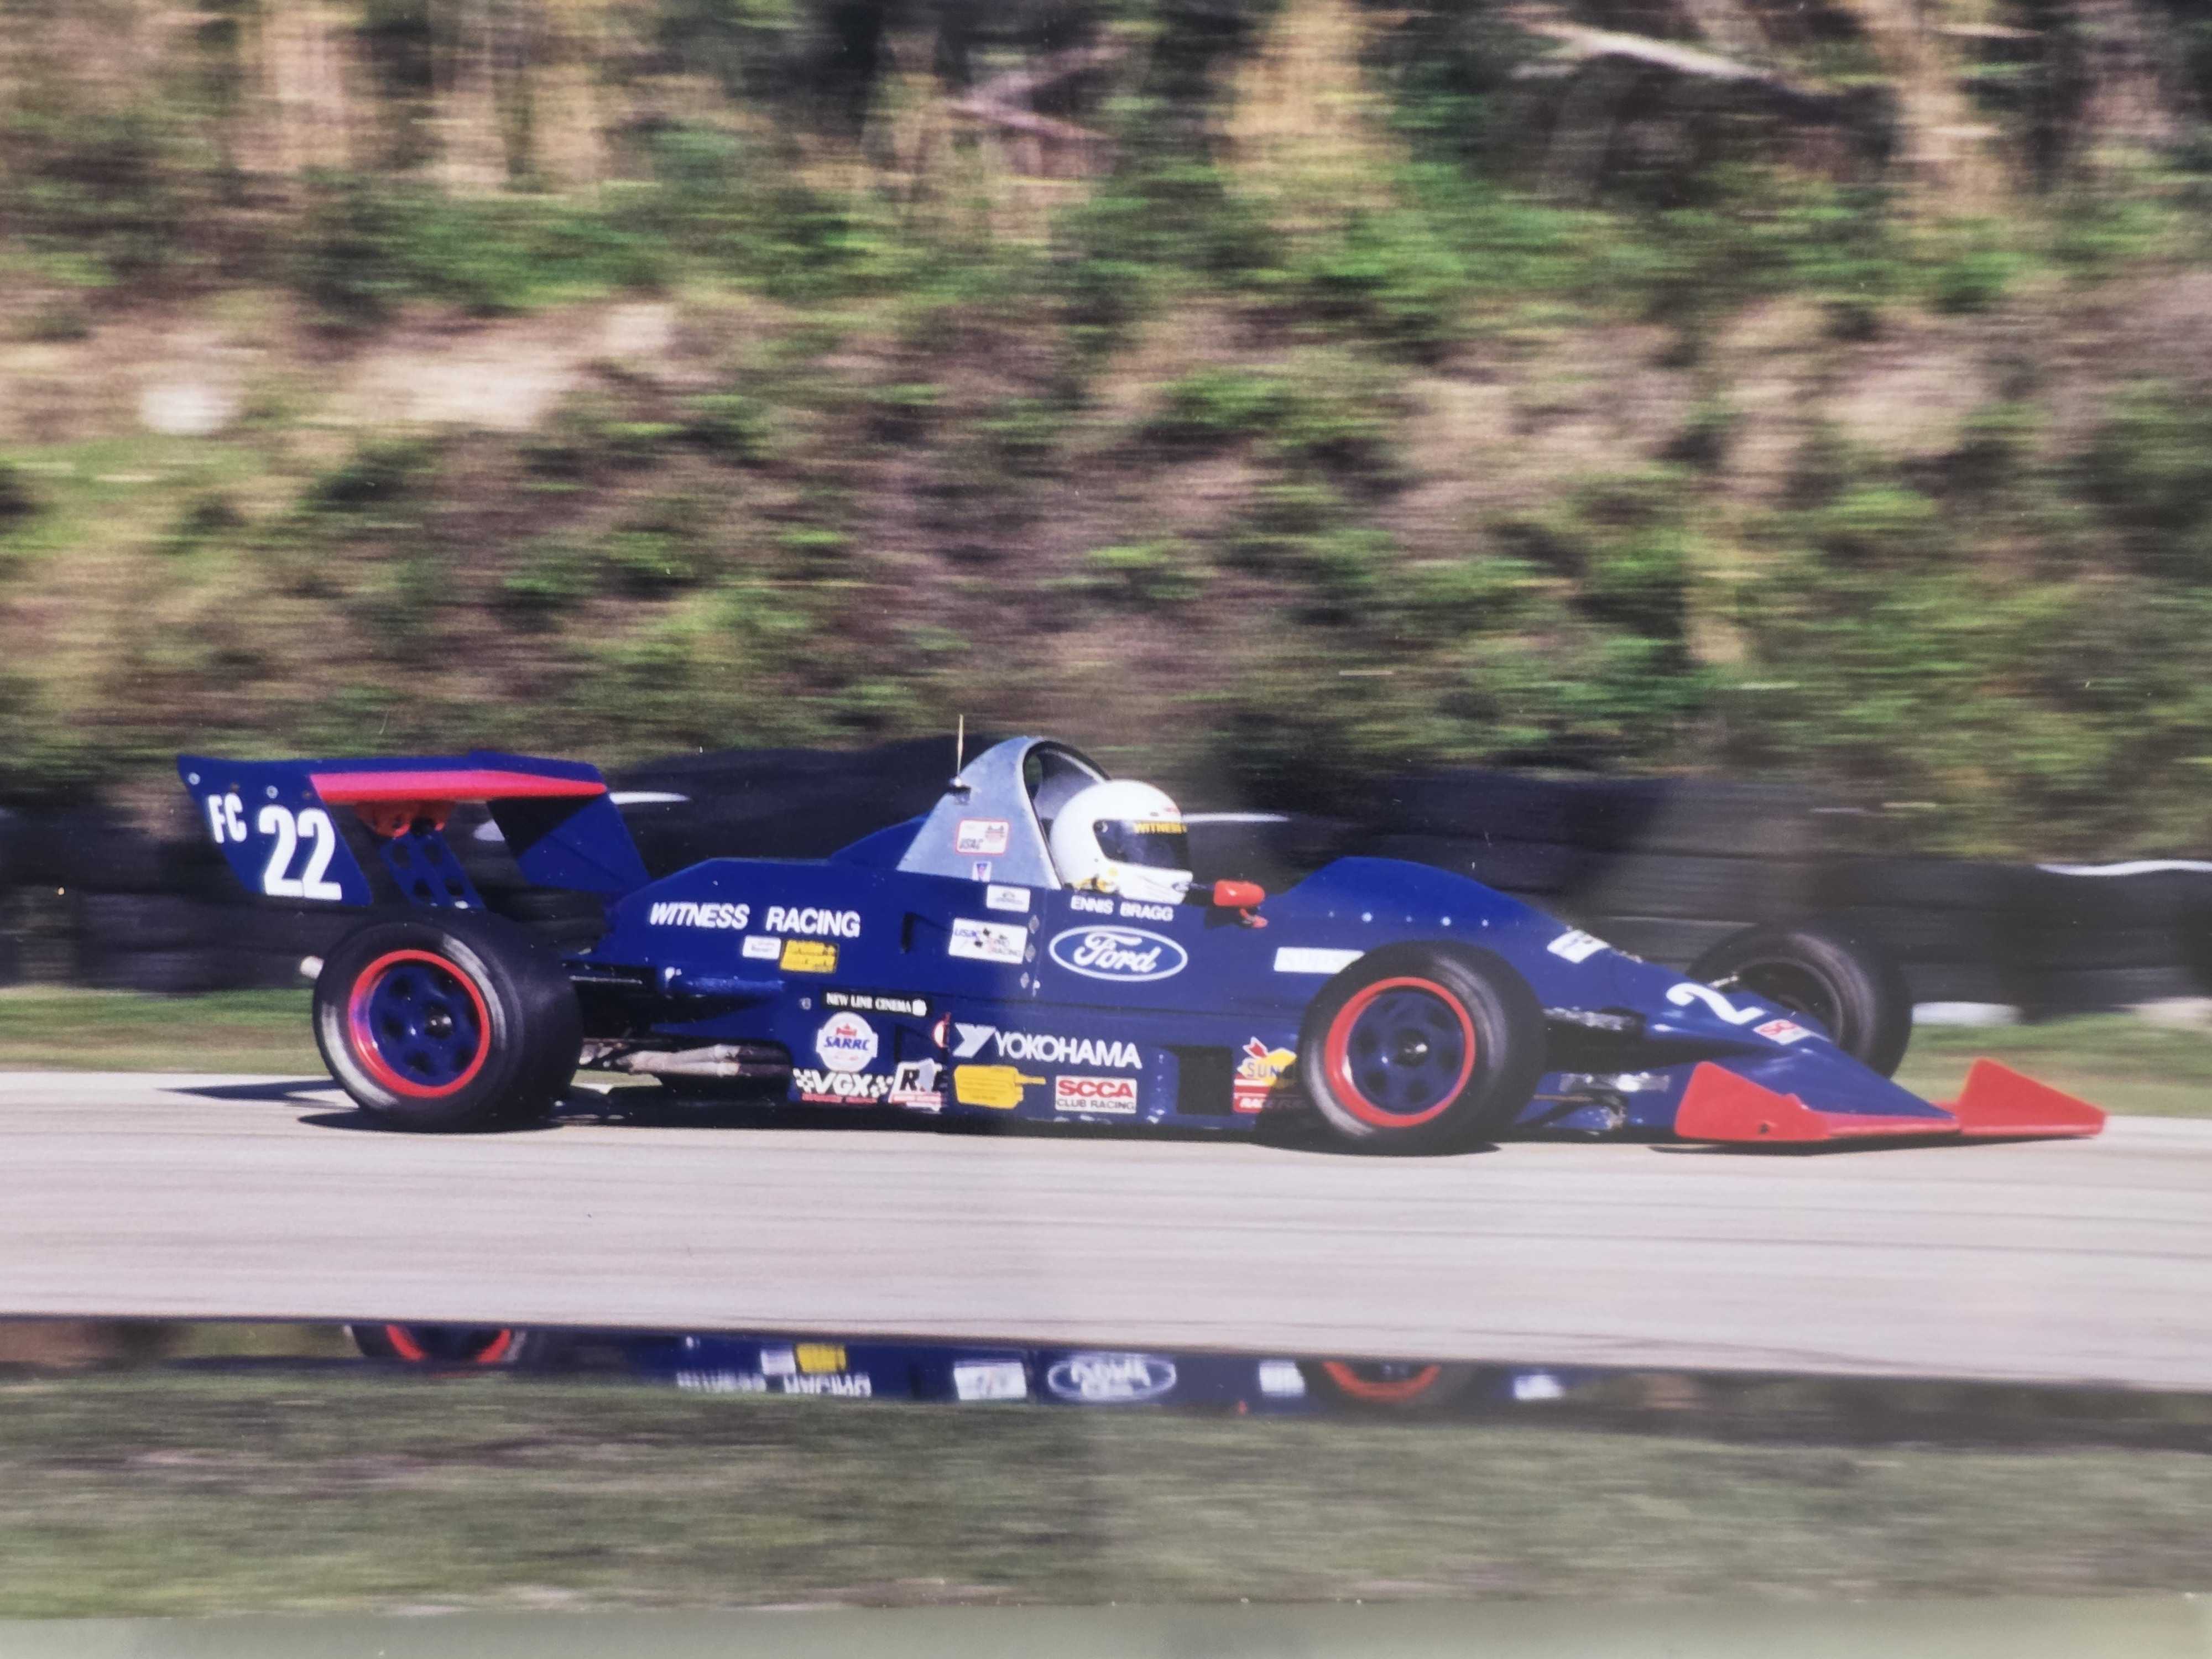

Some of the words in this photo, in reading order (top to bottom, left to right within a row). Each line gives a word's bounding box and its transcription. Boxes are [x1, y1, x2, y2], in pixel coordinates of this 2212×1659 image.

[208, 792, 247, 843] FC
[258, 805, 342, 900] 22
[650, 901, 750, 930] WITNESS
[765, 906, 860, 938] RACING
[1120, 901, 1173, 922] BRAGG
[1074, 932, 1160, 973] Ford
[1666, 982, 1765, 1026] 2
[824, 1036, 870, 1051] SARRC
[995, 1031, 1142, 1070] YOKOHAMA
[1057, 1098, 1086, 1108] CLUB
[1091, 1100, 1135, 1110] RACING
[1058, 1079, 1134, 1098] SCCA
